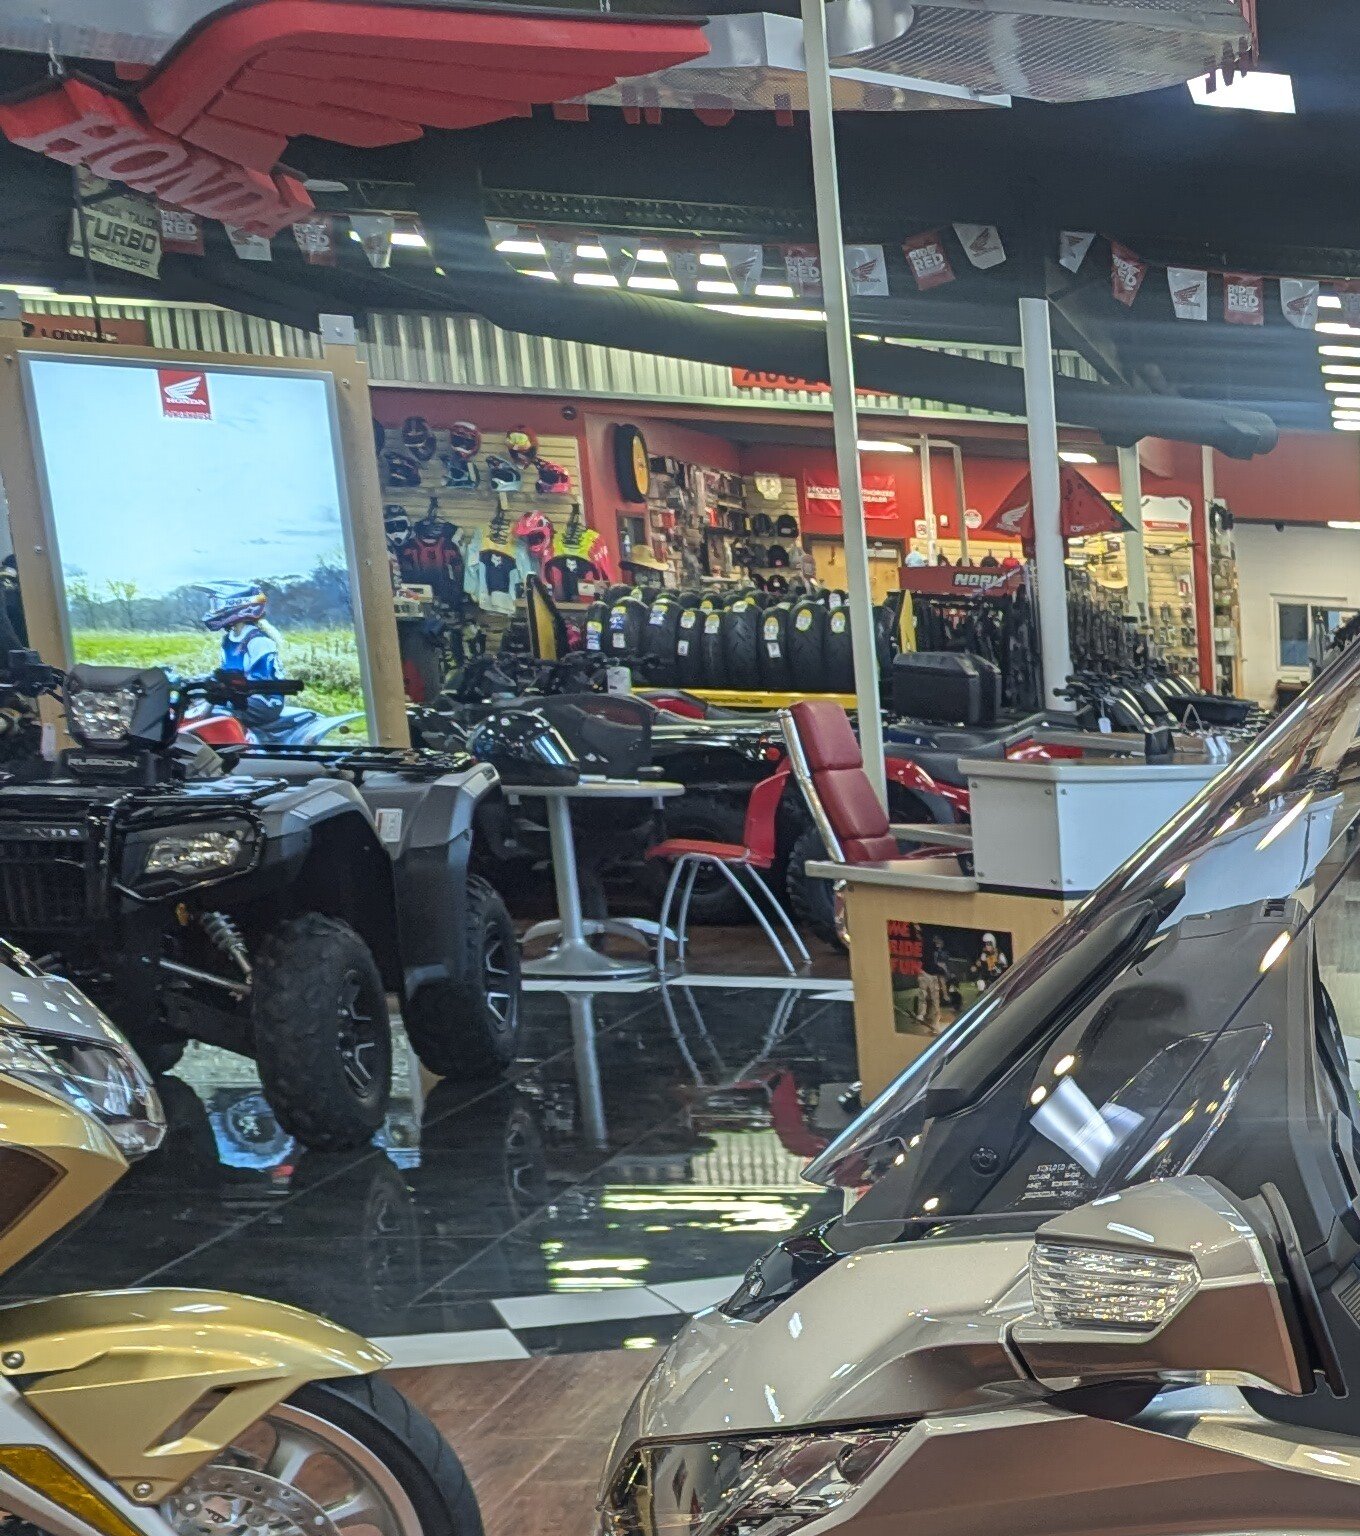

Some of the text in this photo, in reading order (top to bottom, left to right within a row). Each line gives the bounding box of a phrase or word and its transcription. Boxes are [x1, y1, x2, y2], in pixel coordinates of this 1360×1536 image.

[911, 252, 946, 272] RED
[787, 265, 820, 280] RED
[1228, 294, 1260, 309] RED
